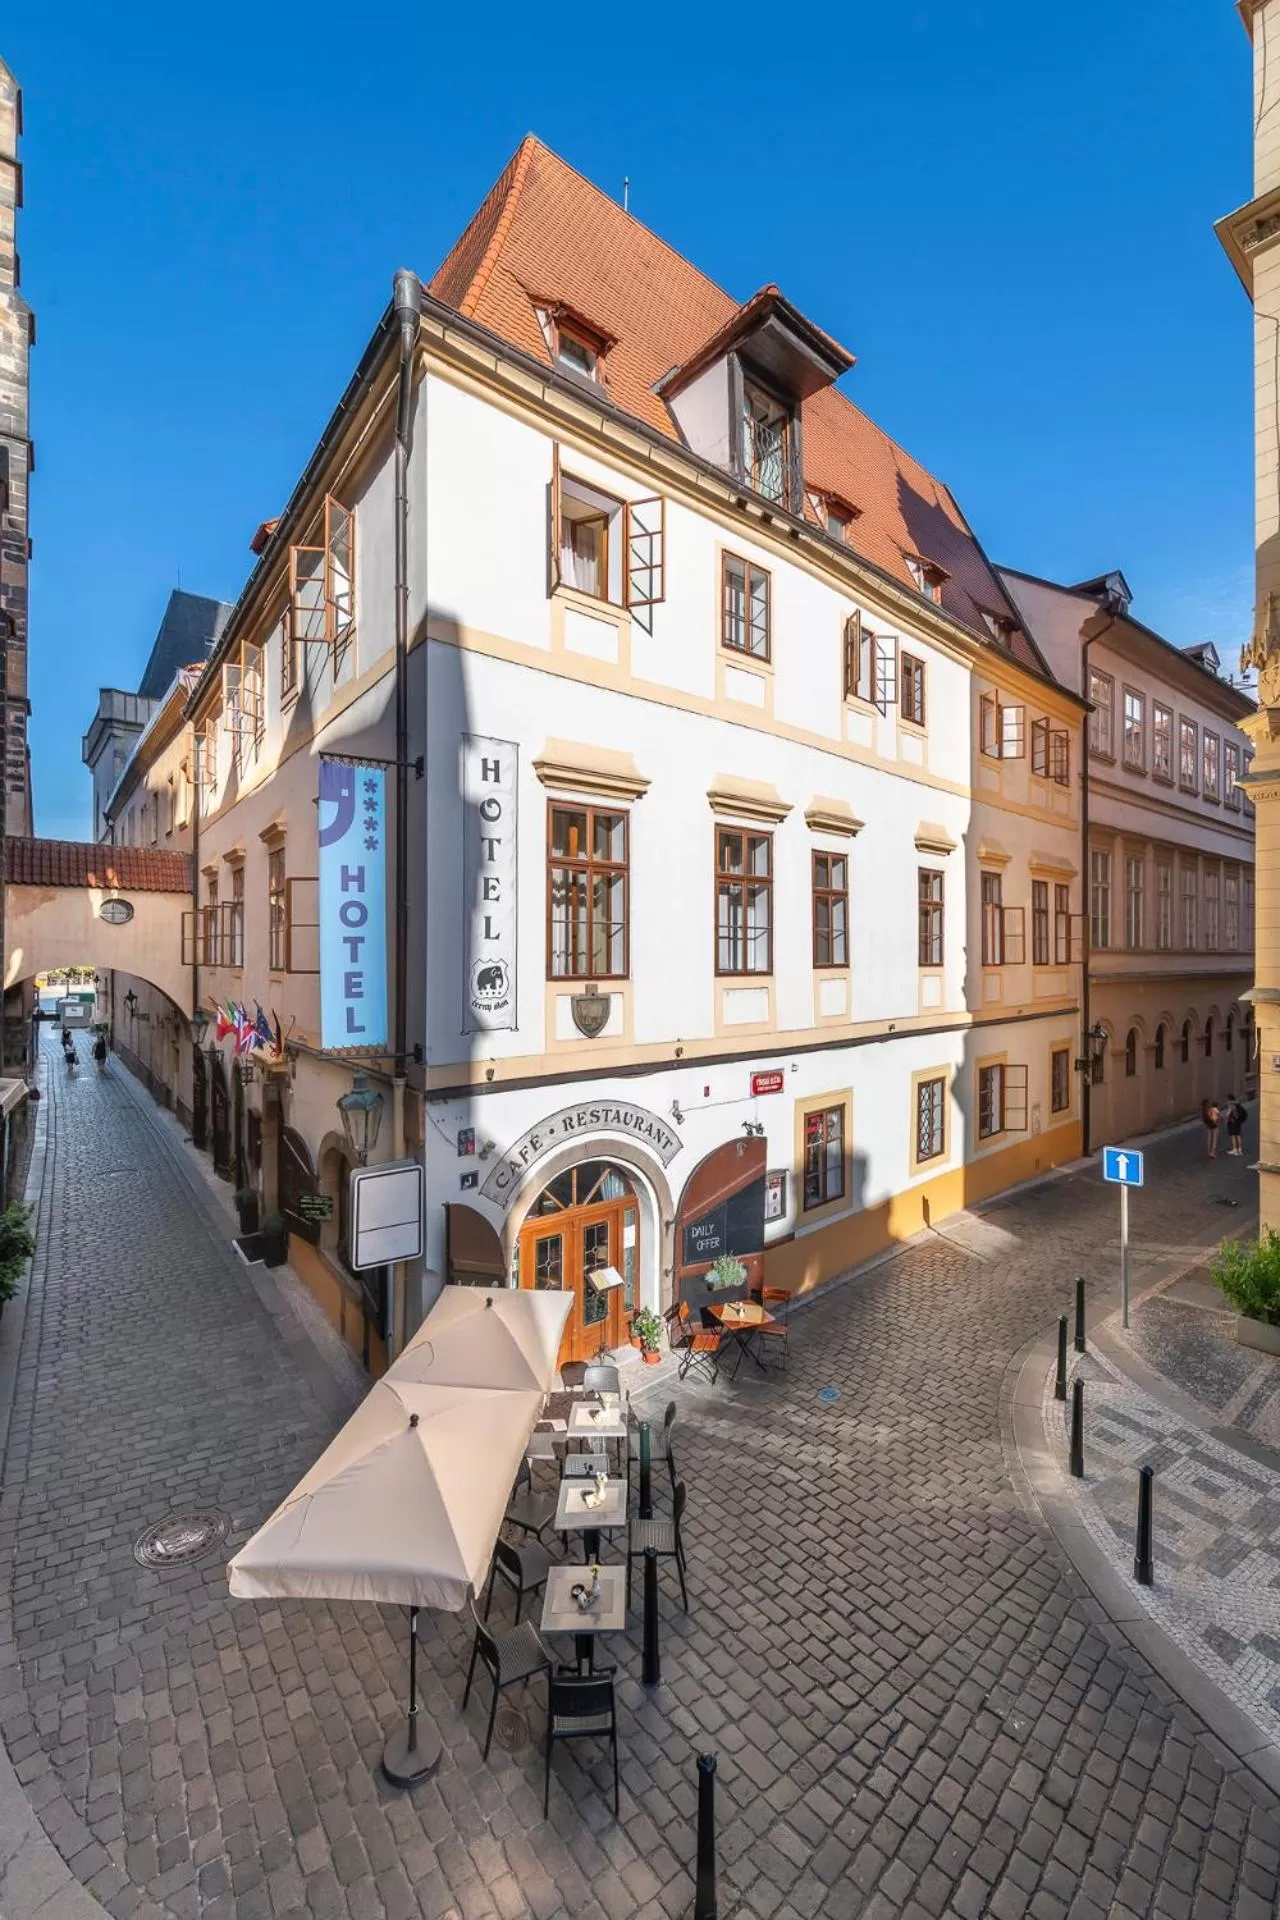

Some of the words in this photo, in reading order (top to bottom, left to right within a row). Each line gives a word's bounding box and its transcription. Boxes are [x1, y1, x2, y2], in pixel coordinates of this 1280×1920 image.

[479, 758, 502, 940] HOTEL
[339, 865, 368, 1034] HOTEL
[496, 1134, 544, 1188] CAFÉ
[562, 1109, 673, 1150] RESTAURANT
[691, 1224, 714, 1238] DAILY
[696, 1237, 720, 1251] OFFER
